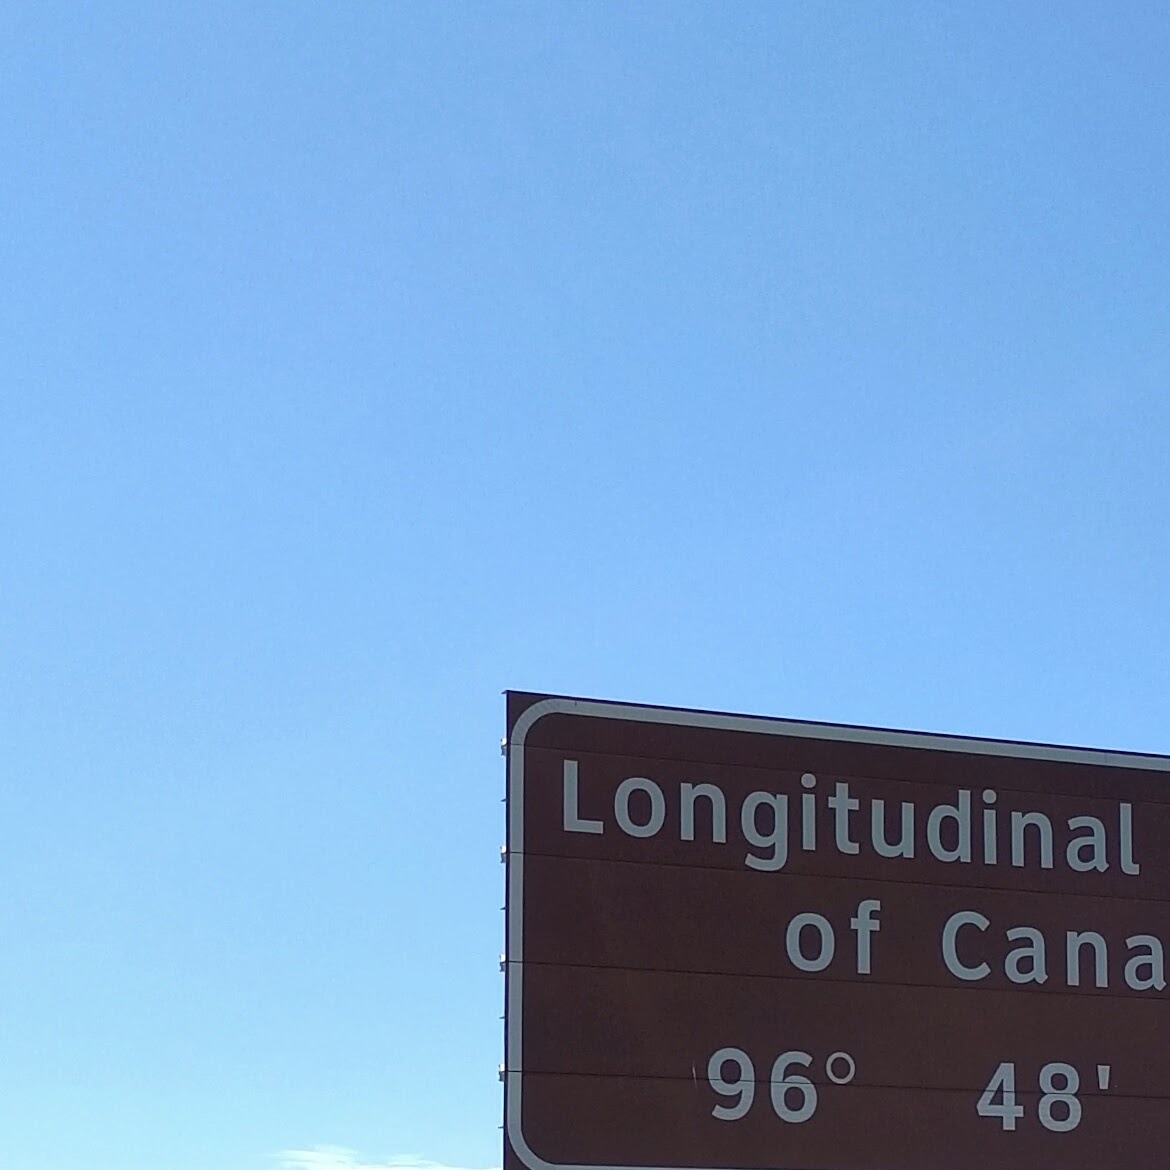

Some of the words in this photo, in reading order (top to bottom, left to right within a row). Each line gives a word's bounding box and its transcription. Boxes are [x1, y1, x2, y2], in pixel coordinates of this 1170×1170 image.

[563, 759, 1140, 876] Longitudinal
[785, 900, 881, 975] of
[707, 1047, 856, 1123] 96°
[976, 1062, 1111, 1132] 48'
